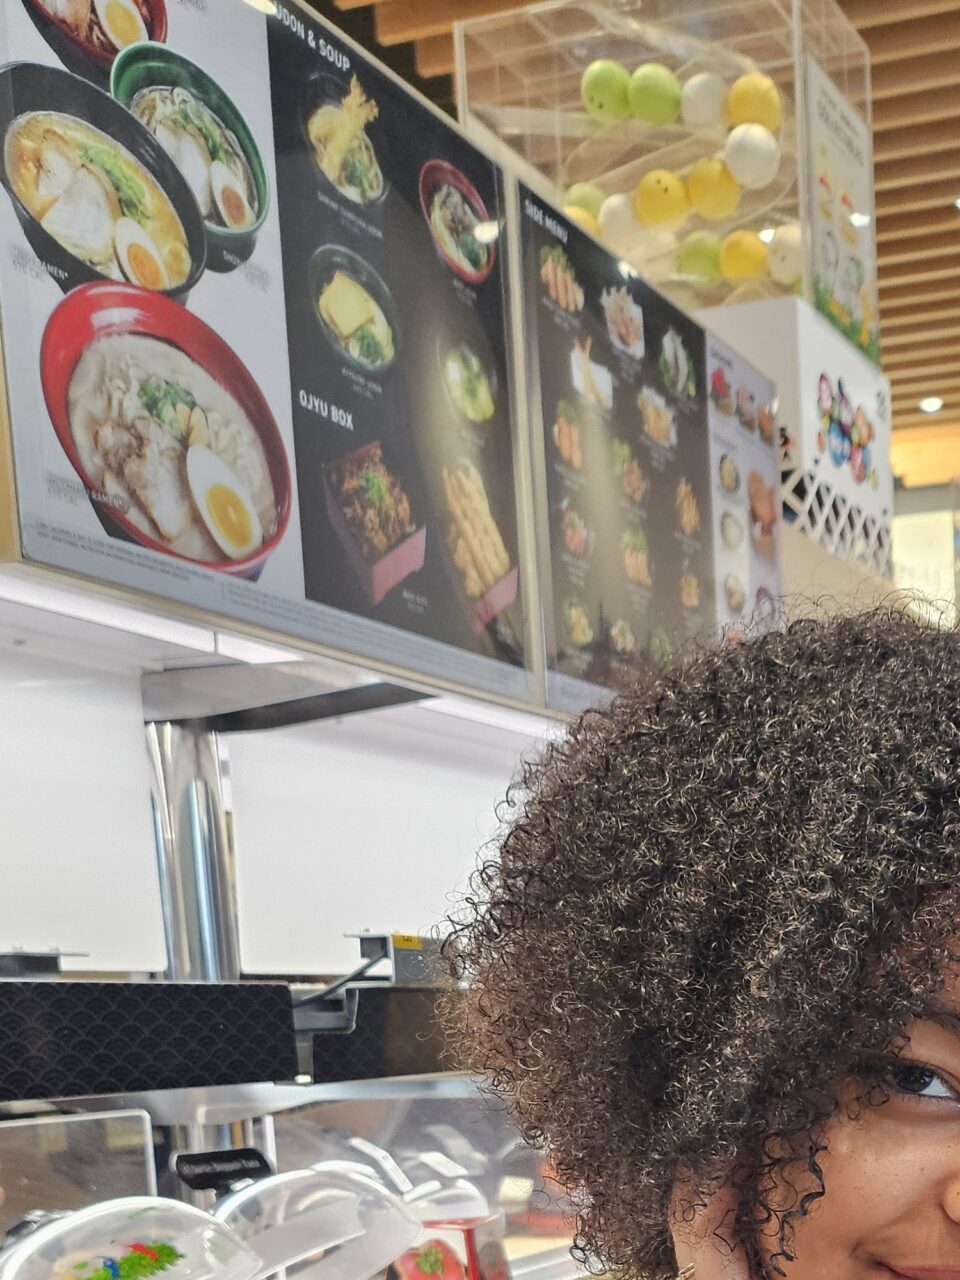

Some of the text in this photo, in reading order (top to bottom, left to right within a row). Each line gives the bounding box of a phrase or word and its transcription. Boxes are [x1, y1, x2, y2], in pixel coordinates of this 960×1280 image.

[307, 29, 316, 49] &
[318, 38, 351, 72] SOUP
[299, 389, 354, 431] OJYU BOX
